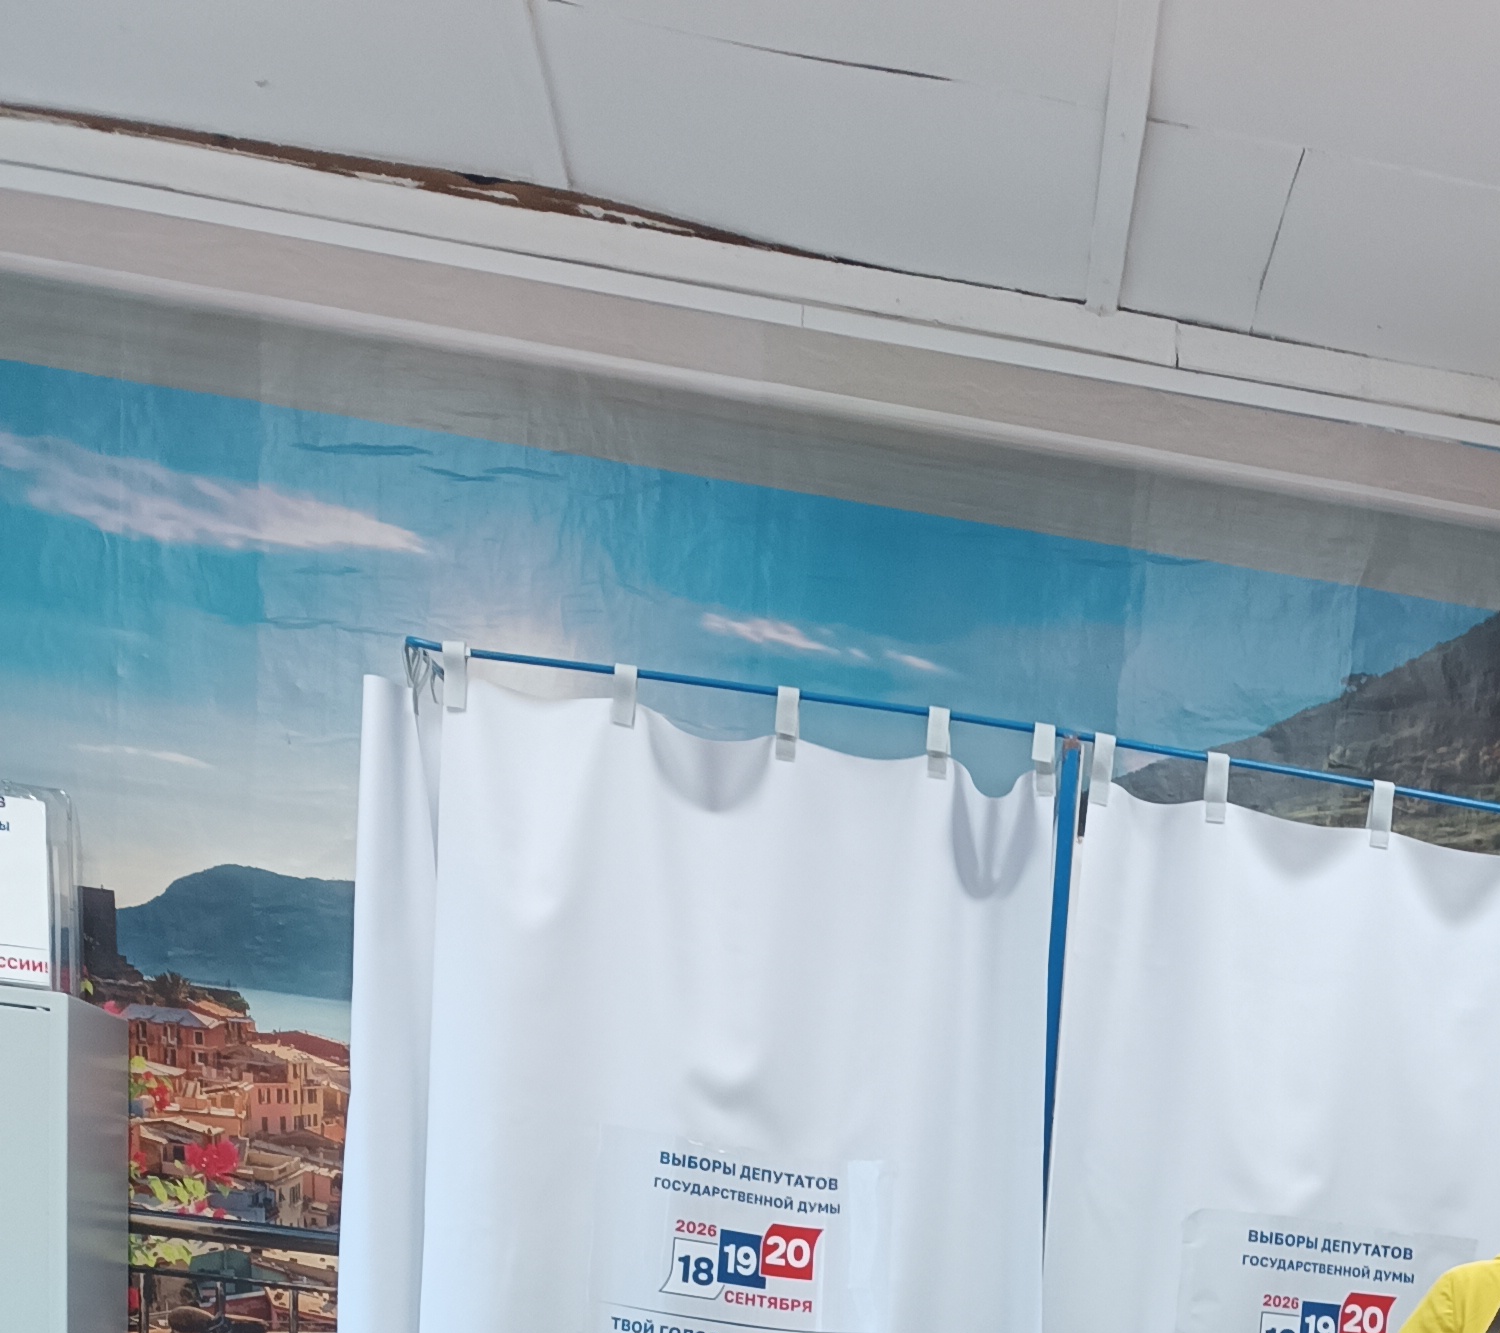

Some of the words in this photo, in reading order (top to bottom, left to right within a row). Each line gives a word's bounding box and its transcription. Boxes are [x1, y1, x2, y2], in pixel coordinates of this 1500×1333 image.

[659, 1151, 736, 1176] ВЫБОРЫ
[740, 1165, 838, 1190] ДЕПУТАТОВ
[654, 1177, 793, 1211] ГОСУДАРСТВЕННОЙ
[797, 1200, 841, 1214] ДУМЫ
[675, 1219, 717, 1237] 2026
[1248, 1229, 1318, 1249] ВЫБОРЫ
[1321, 1239, 1414, 1260] ДЕПУТАТОВ
[678, 1255, 714, 1286] 18
[724, 1244, 758, 1276] 19
[765, 1235, 811, 1268] 20
[1242, 1254, 1370, 1280] ГОСУДАРСТВЕННОЙ
[1373, 1269, 1415, 1284] ДУМЫ
[724, 1290, 813, 1313] СЕНТЯБРЯ
[1263, 1294, 1299, 1309] 2026
